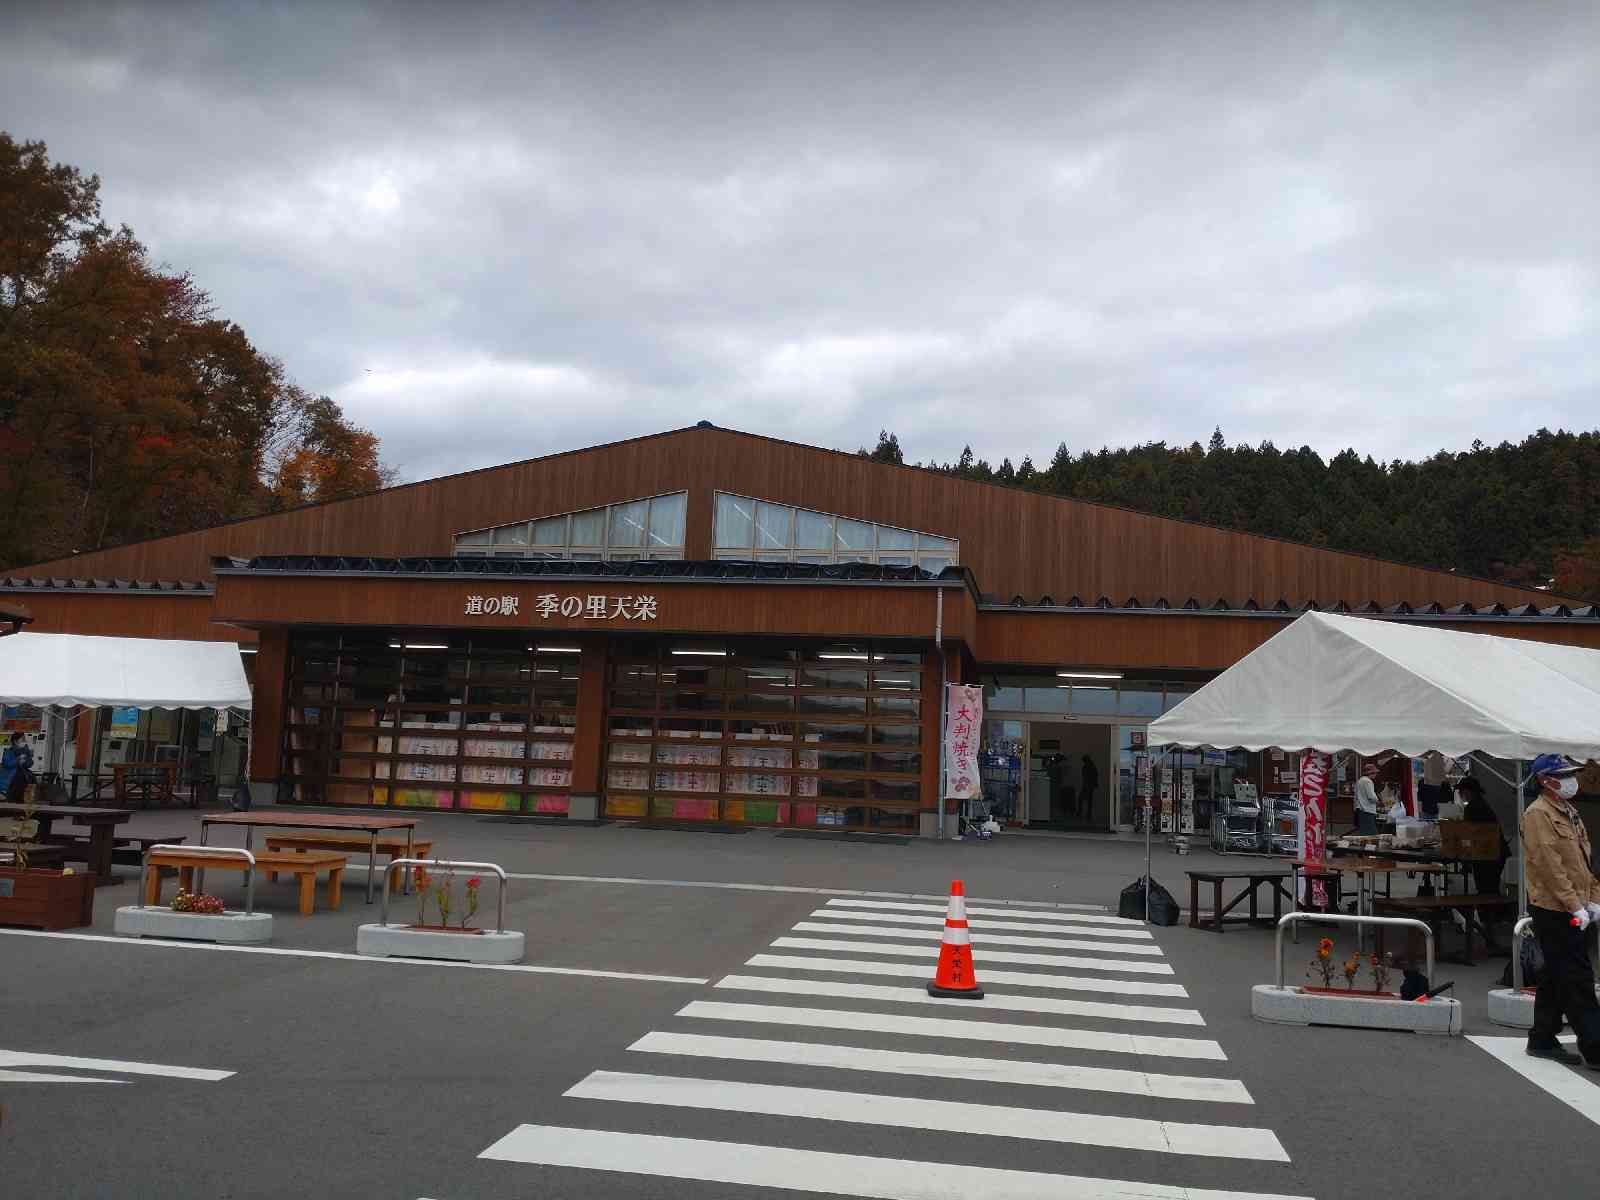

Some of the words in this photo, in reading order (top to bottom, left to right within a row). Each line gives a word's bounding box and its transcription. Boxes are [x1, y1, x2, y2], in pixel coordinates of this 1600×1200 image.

[464, 595, 519, 616] 道の駅
[535, 593, 657, 621] 季の里天栄
[951, 704, 973, 774] 大判焼き
